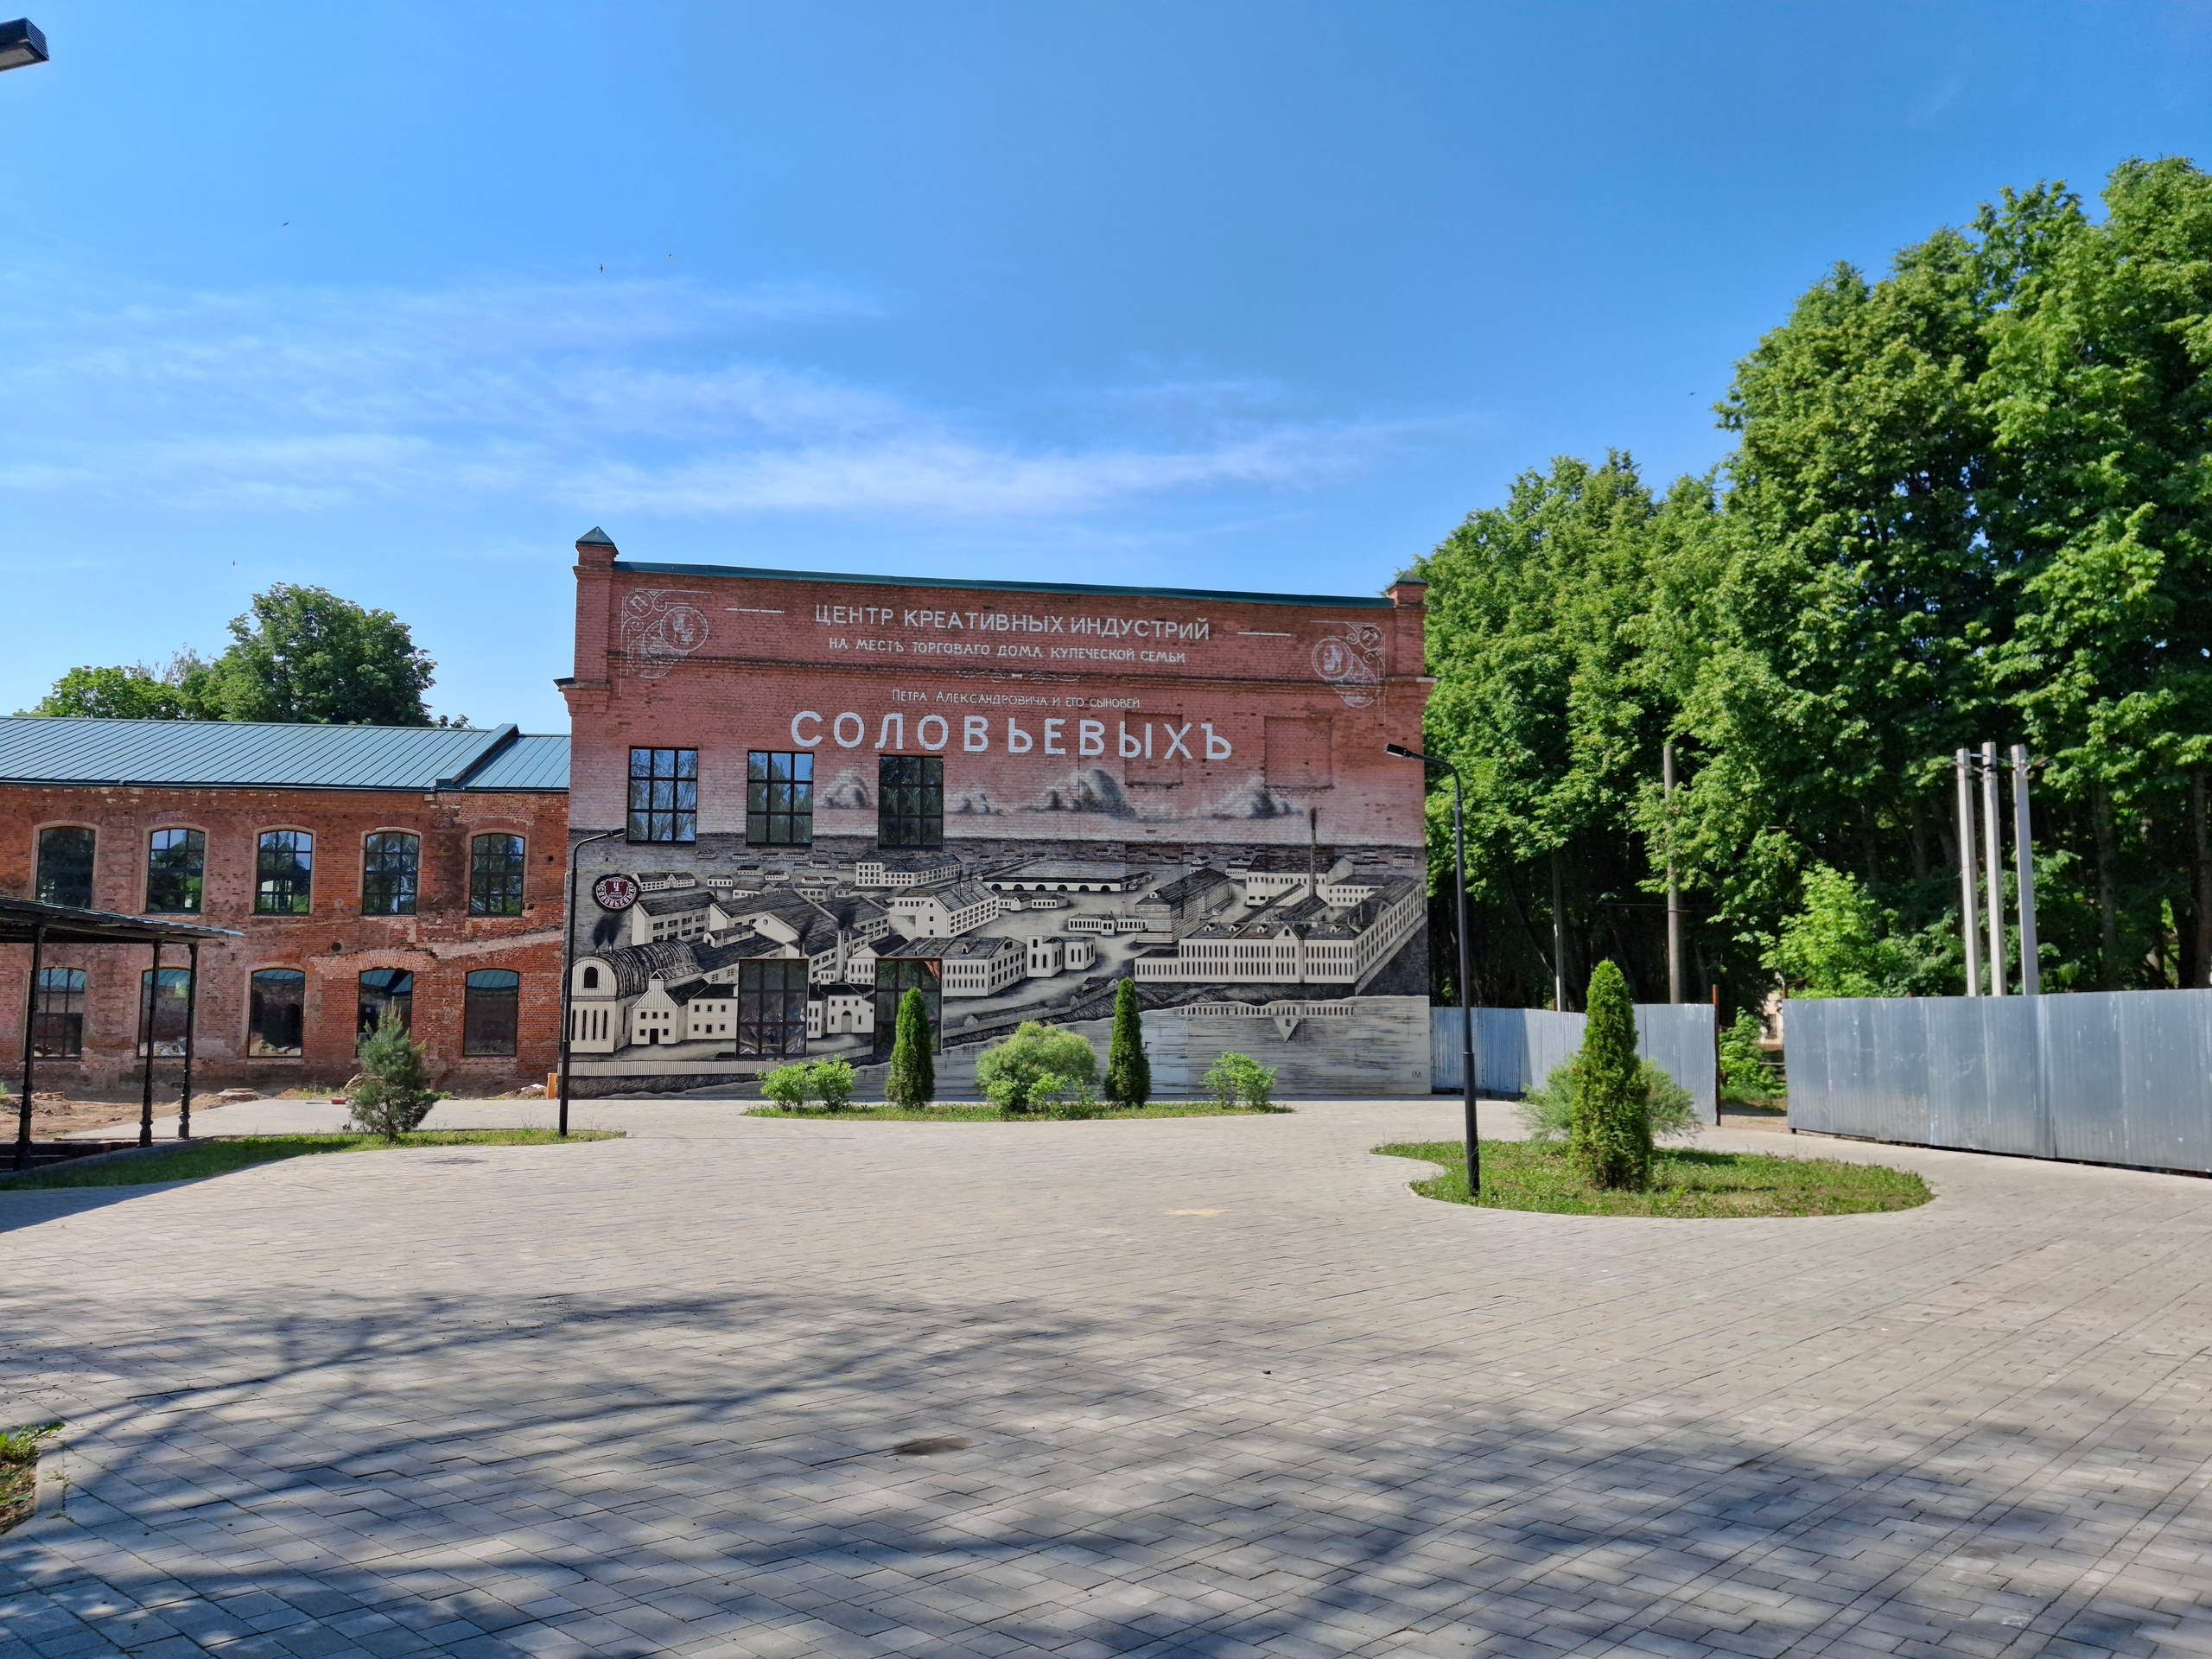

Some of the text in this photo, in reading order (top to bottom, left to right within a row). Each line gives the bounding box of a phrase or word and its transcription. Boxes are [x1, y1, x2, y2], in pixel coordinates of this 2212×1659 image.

[816, 604, 1210, 640] ЦЕНТР КРЕАТИВНЫХ ИНДУСТРИЙ
[829, 637, 849, 650] НА
[912, 641, 990, 656] ТОРГОВАГО
[997, 645, 1043, 658] ДОМА
[1051, 647, 1135, 662] КУПЕЧЕСКОЙ
[1141, 651, 1186, 663] СЕМЬИ
[1052, 697, 1061, 707] И
[1065, 696, 1084, 708] ЕГО
[1090, 696, 1141, 709] СЫНОВЕЙ
[791, 710, 1233, 760] СОЛОВЬЕВЫХЪ
